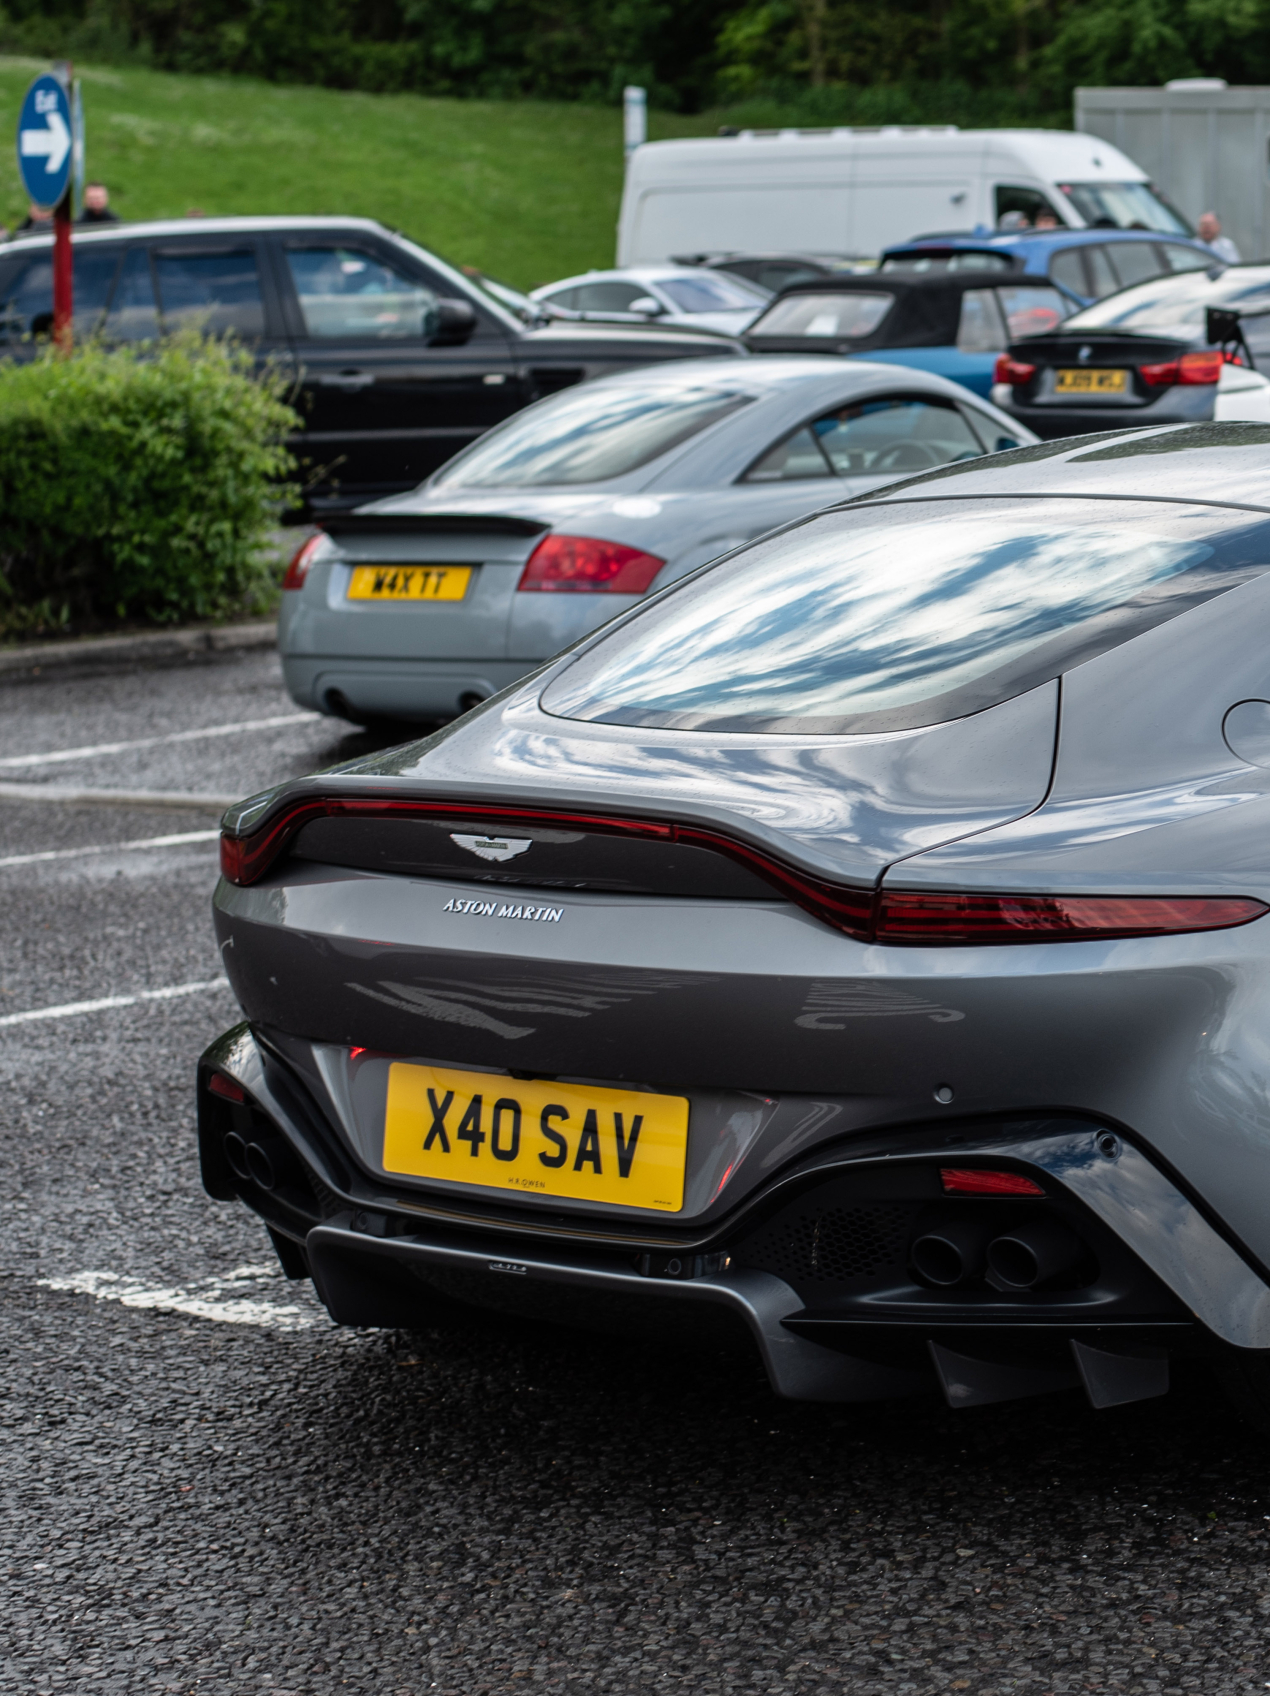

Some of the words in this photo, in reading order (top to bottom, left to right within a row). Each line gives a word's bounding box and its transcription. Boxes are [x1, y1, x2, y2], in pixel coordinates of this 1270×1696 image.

[420, 570, 449, 595] TT
[443, 898, 498, 917] ASTON
[498, 904, 565, 923] MARTIN
[423, 1088, 522, 1162] X40
[538, 1103, 645, 1179] SAV
